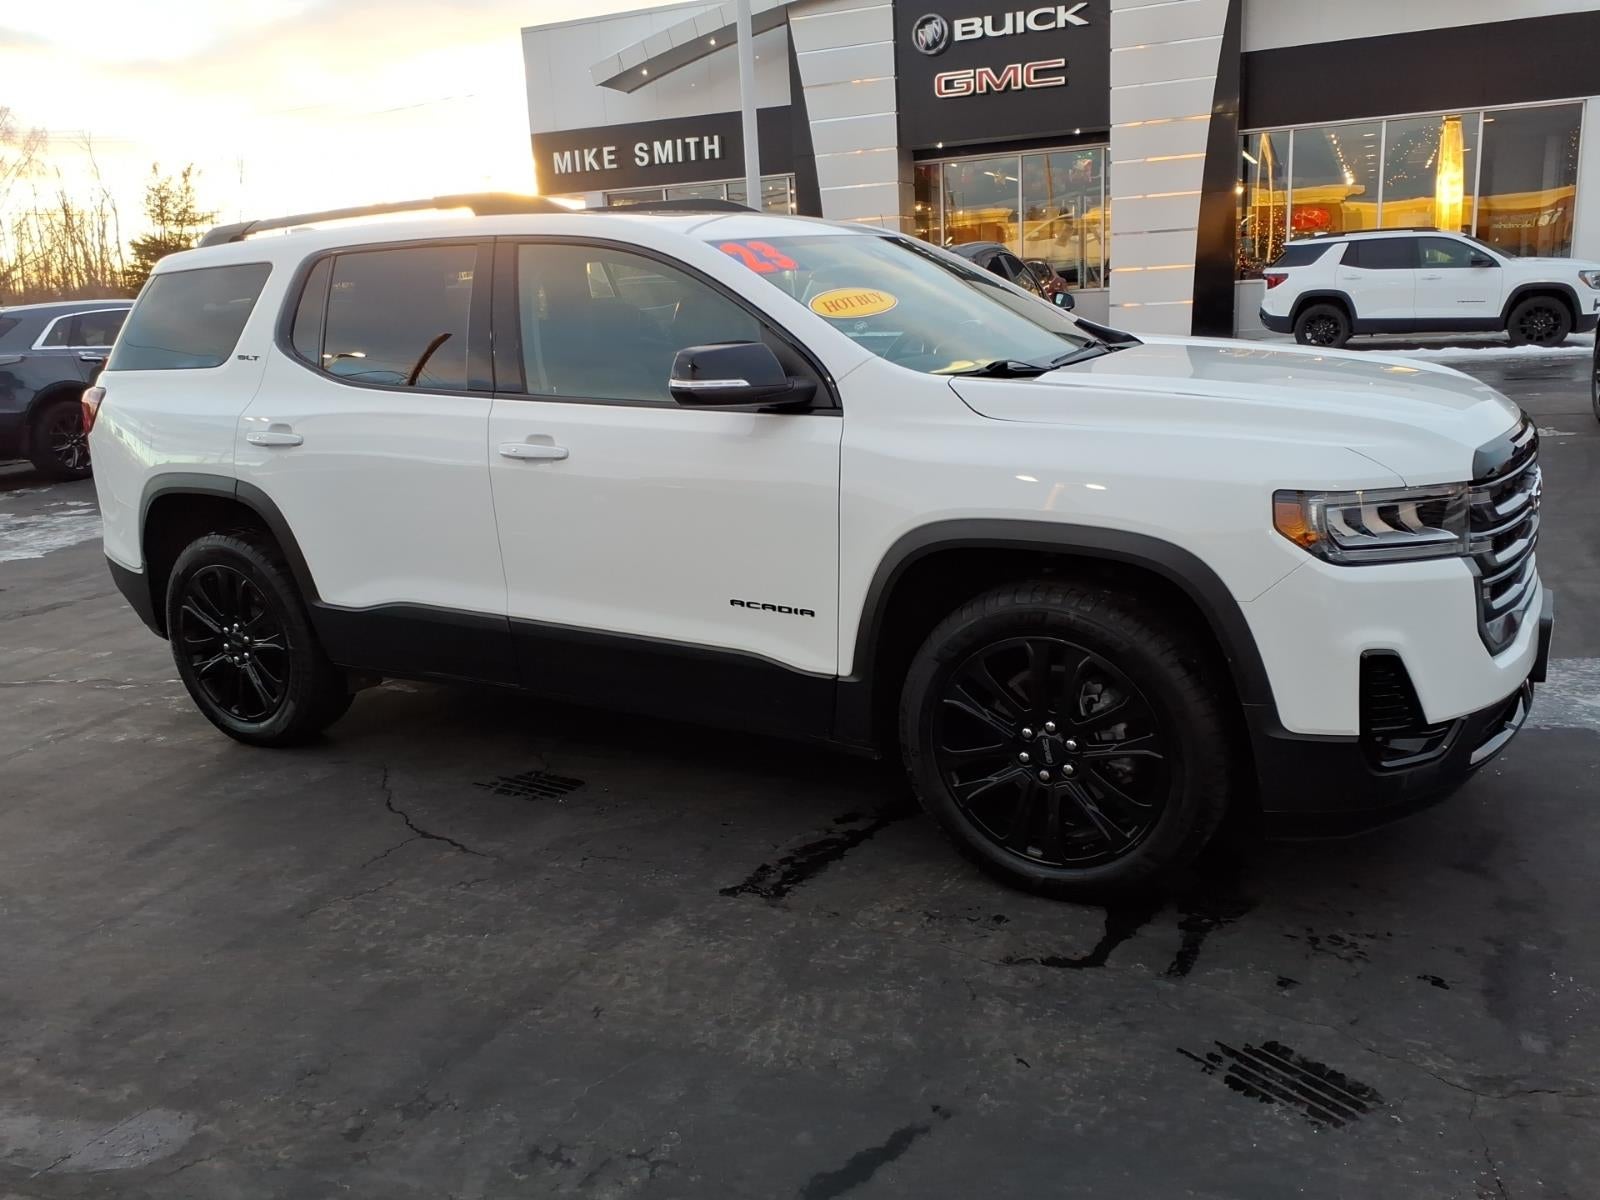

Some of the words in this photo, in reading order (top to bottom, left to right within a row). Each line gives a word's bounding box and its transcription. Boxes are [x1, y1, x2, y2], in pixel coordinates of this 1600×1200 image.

[954, 2, 1089, 41] BUICK
[935, 58, 1066, 98] GMC
[553, 146, 618, 175] MIKE
[634, 135, 720, 167] SMITH
[719, 240, 797, 274] 23
[822, 297, 855, 313] HOT
[855, 292, 884, 306] BUY
[729, 599, 815, 617] ACADIA
